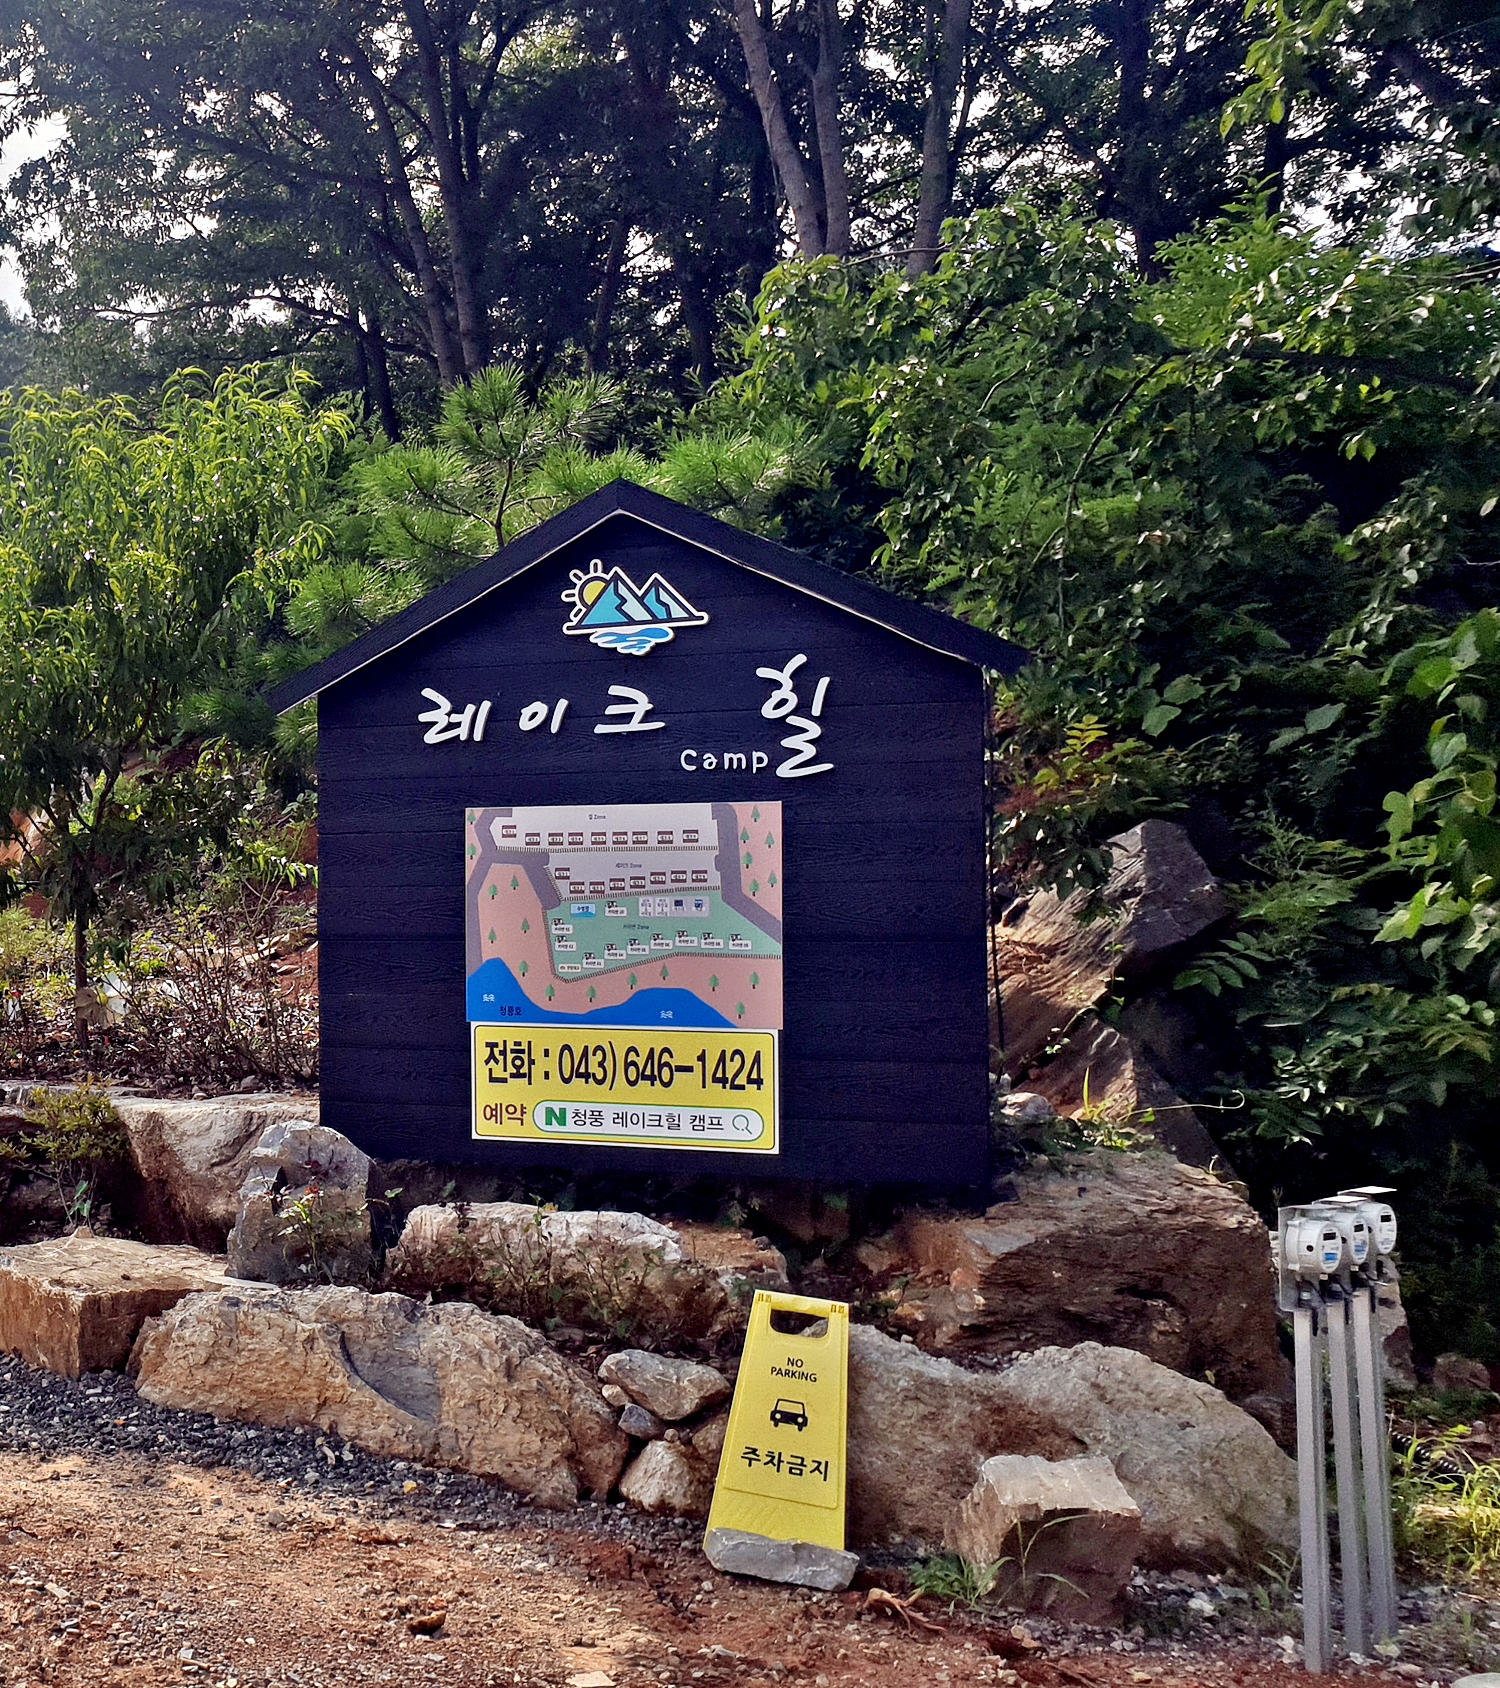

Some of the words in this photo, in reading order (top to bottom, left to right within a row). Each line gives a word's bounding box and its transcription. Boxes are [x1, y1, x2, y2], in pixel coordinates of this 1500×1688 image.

[417, 684, 666, 745] 레이크
[756, 652, 834, 778] 힐
[483, 1039, 536, 1086] 전화
[482, 1102, 527, 1127] 예약
[571, 1108, 605, 1129] 청풍
[612, 1111, 681, 1132] 레이크힐
[688, 1113, 725, 1132] 캠프
[770, 1366, 817, 1383] PARKING
[786, 1356, 804, 1369] NO
[740, 1446, 829, 1482] 주차금지
